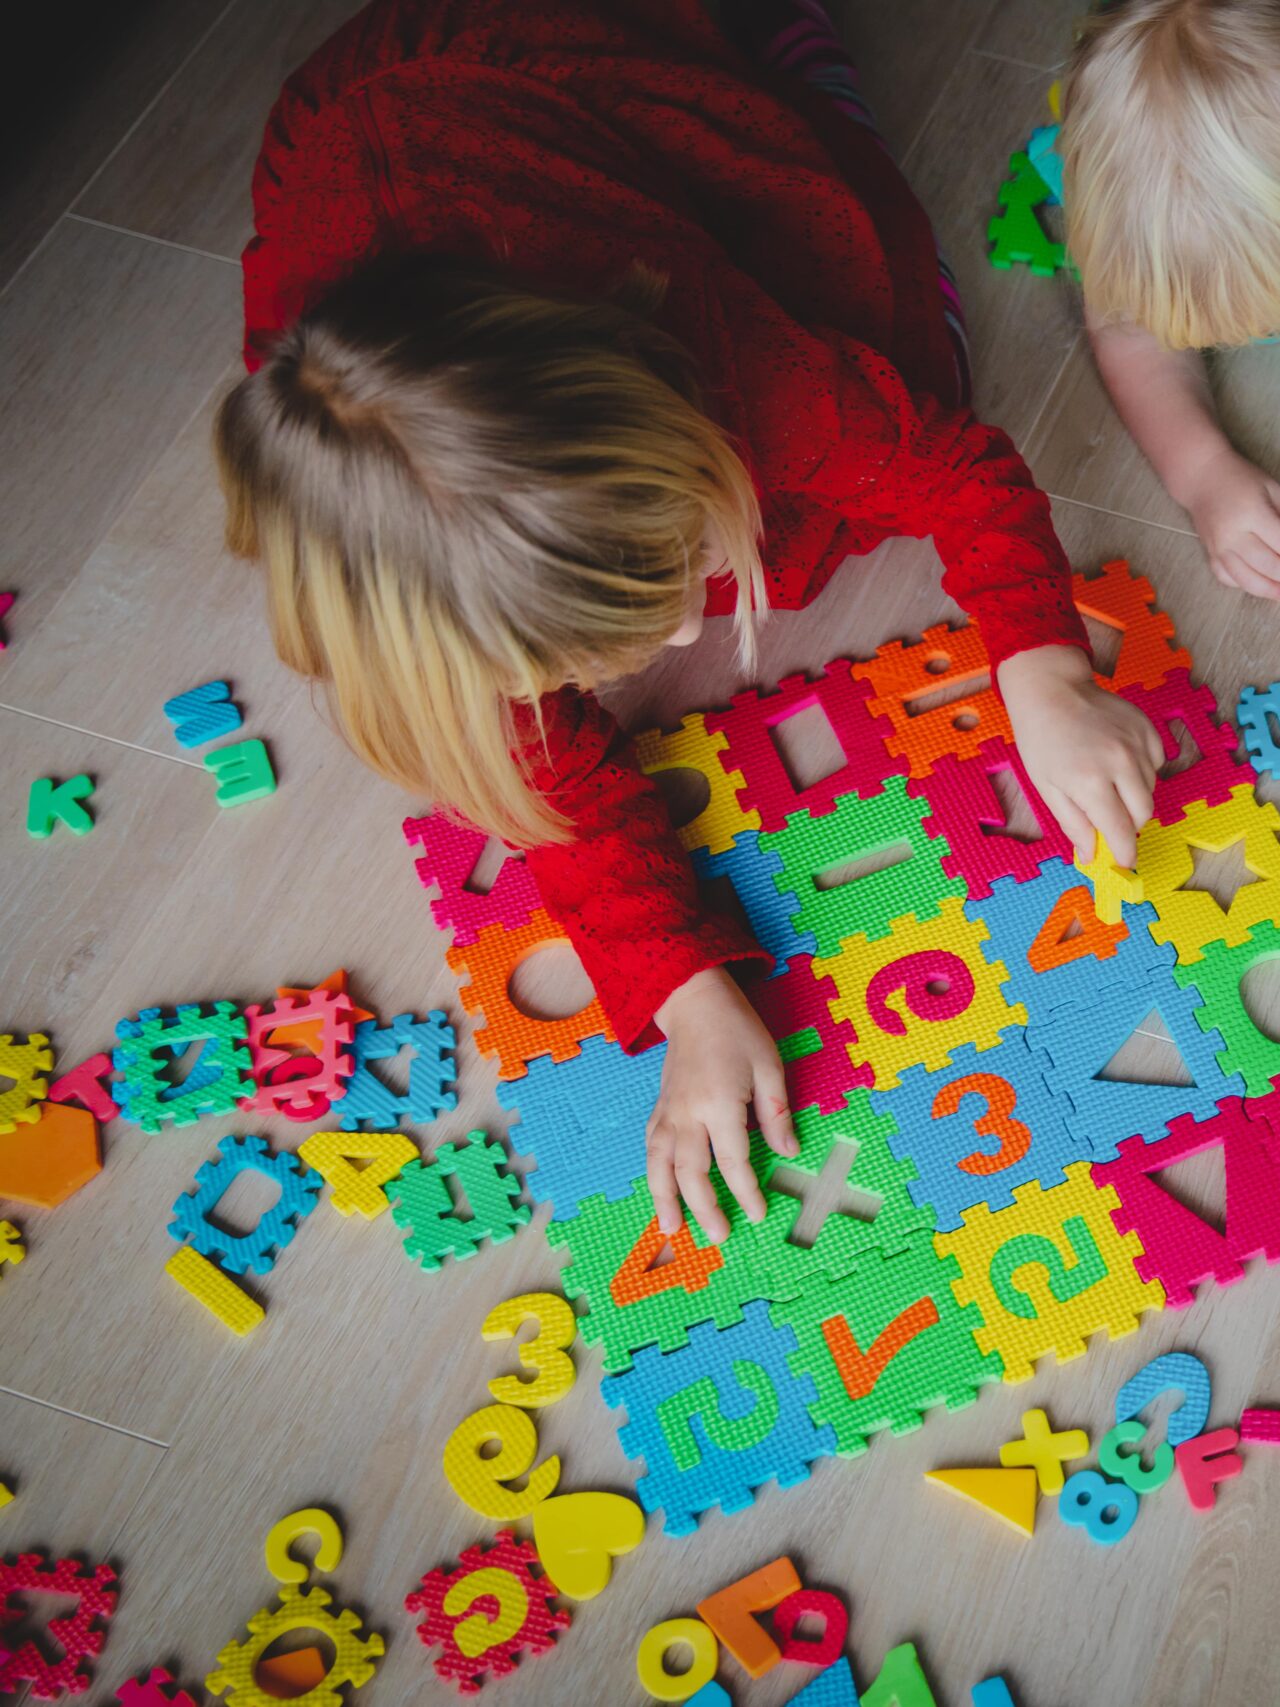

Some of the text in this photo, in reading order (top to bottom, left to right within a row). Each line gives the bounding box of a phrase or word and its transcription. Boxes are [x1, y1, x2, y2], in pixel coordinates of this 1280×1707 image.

[27, 774, 94, 839] K
[930, 1072, 1033, 1177] 3
[297, 1131, 421, 1221] 4
[481, 1292, 578, 1408] 3
[1058, 1470, 1139, 1545] 8
[1173, 1427, 1244, 1512] F
